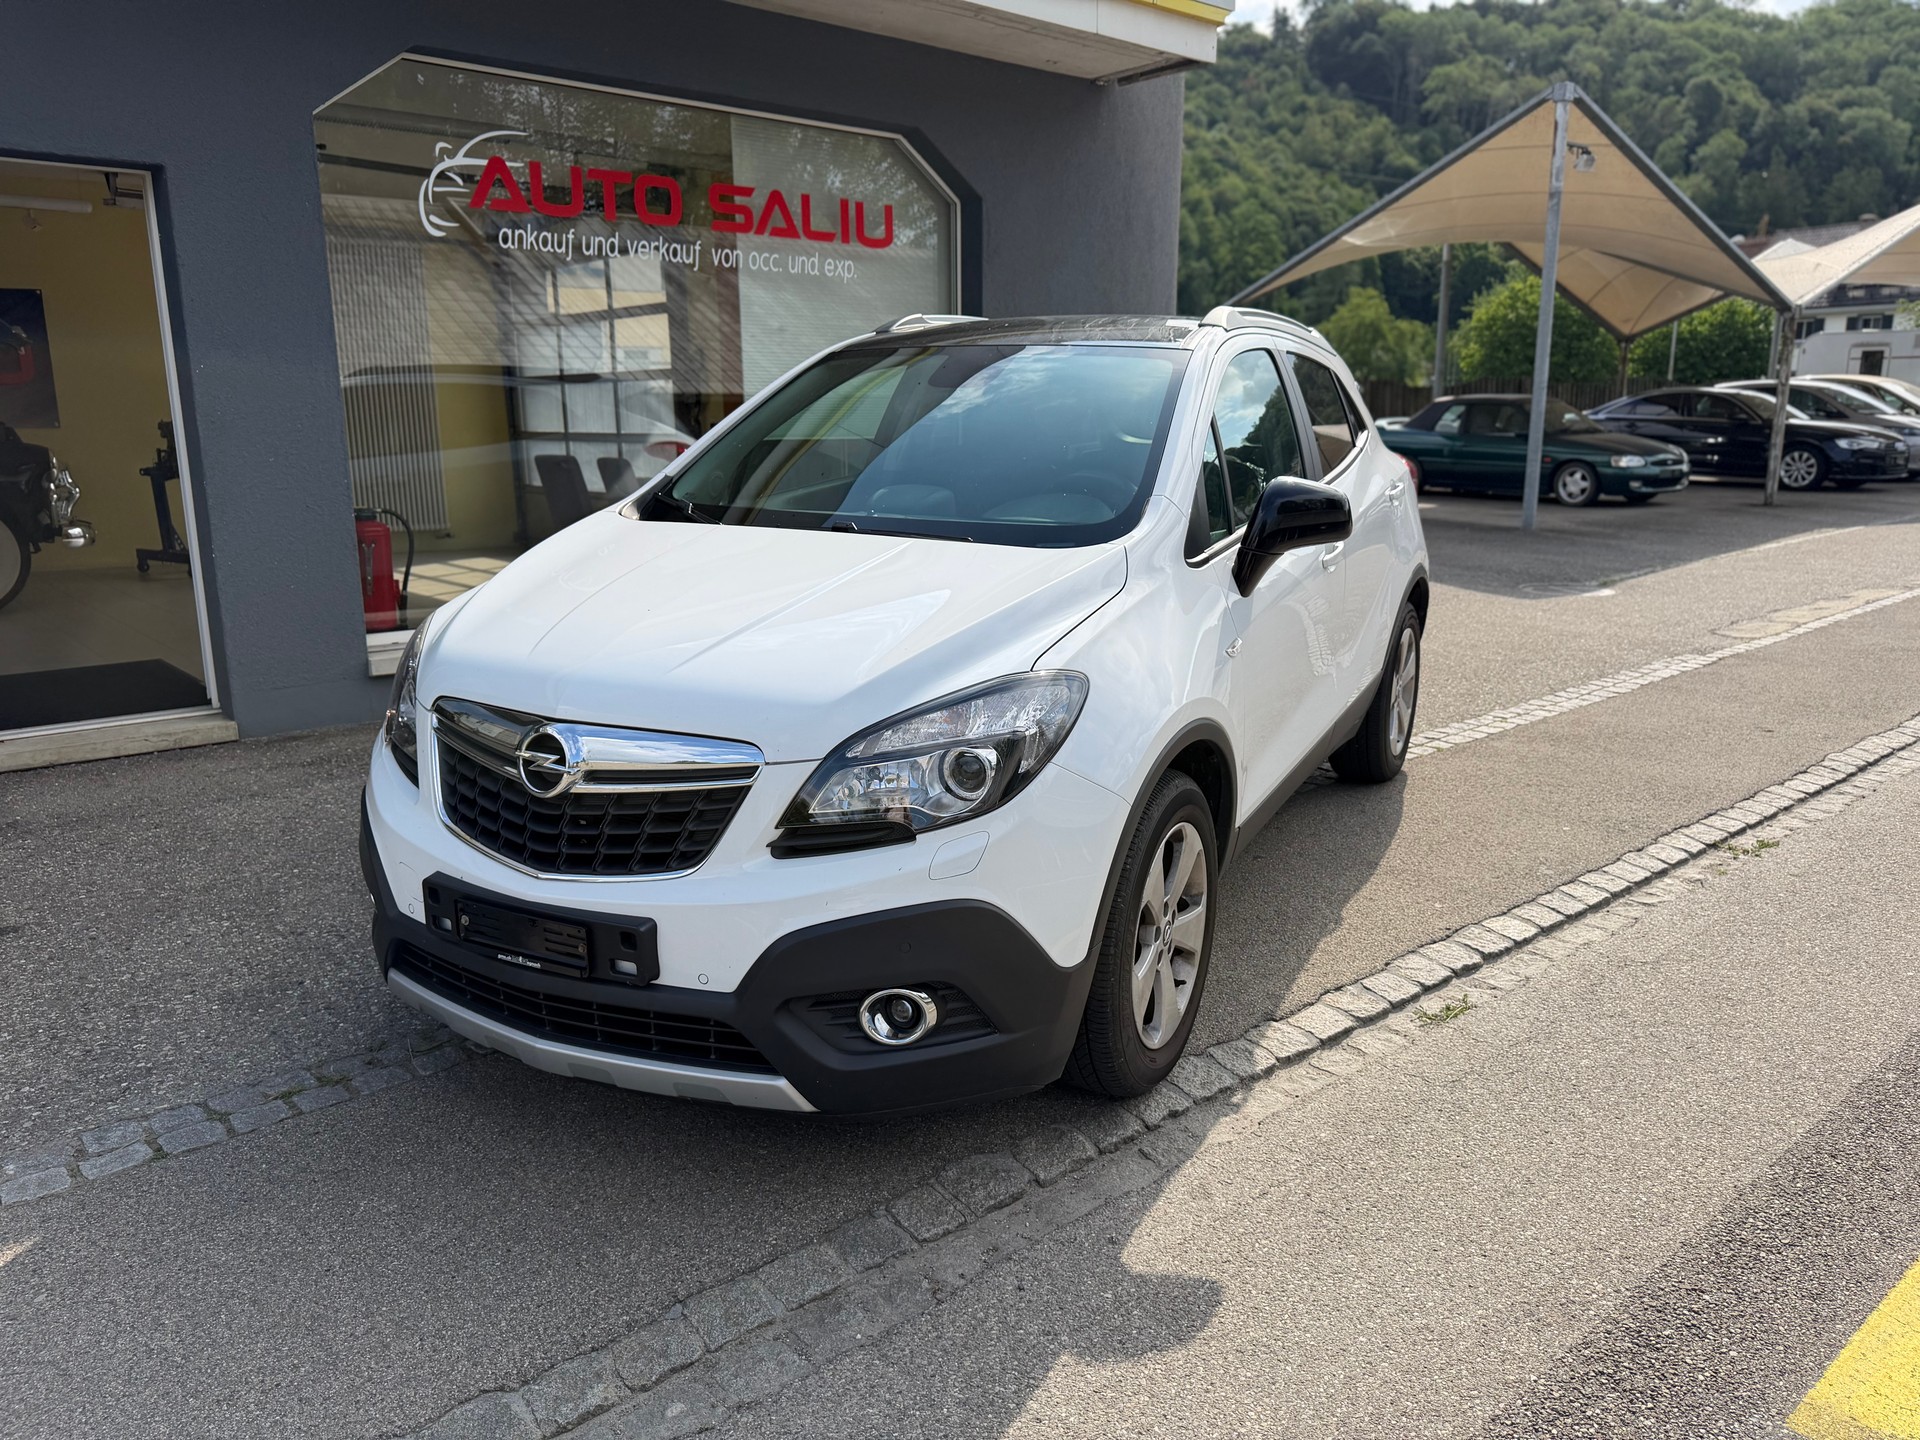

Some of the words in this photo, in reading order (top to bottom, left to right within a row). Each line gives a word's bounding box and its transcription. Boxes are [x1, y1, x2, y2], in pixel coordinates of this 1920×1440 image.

[469, 156, 683, 227] AUTO
[708, 183, 894, 249] SALIU
[498, 224, 575, 261] ankauf
[582, 232, 620, 258] und
[627, 236, 702, 271] verkauf
[711, 247, 743, 269] von
[748, 251, 783, 272] occ.
[788, 252, 820, 276] und
[824, 257, 858, 284] exp.
